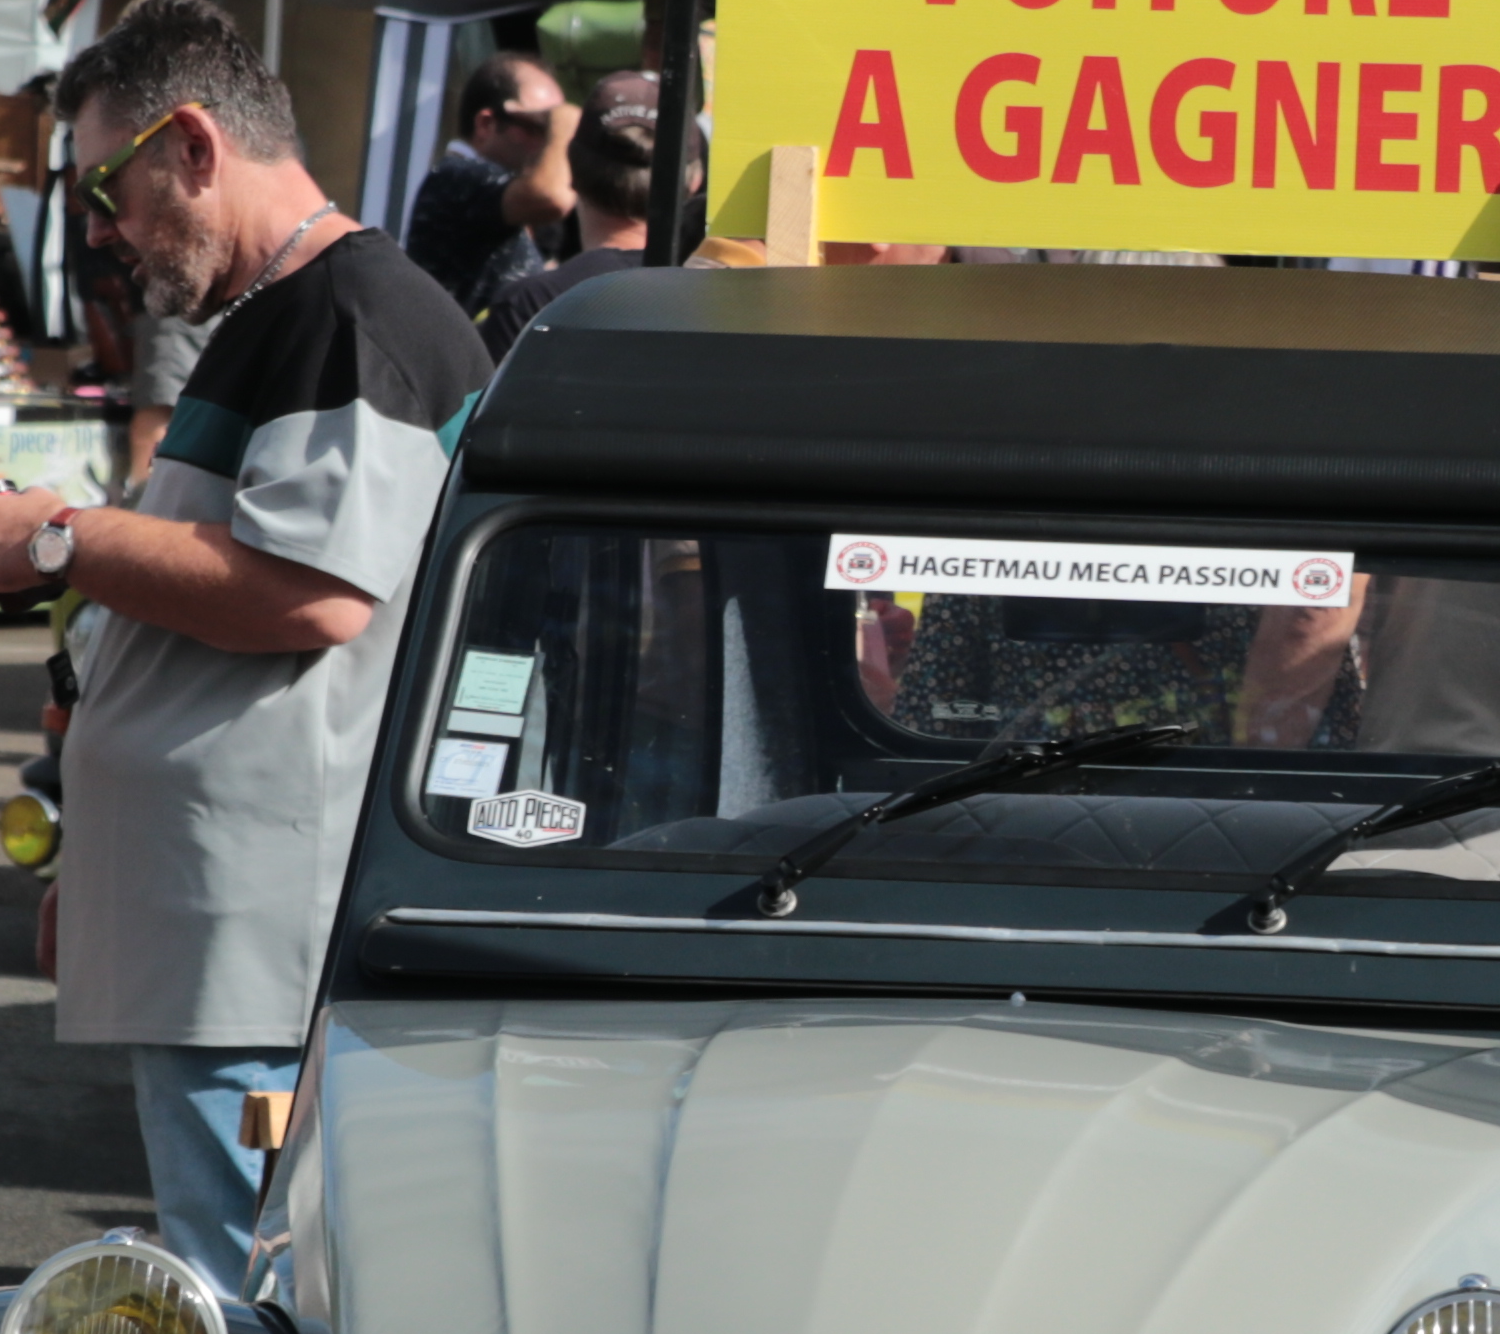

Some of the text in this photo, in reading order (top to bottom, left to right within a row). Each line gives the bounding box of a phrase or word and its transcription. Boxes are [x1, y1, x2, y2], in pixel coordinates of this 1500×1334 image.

[822, 49, 914, 180] A
[899, 554, 1061, 582] HAGETMAU
[1069, 560, 1150, 585] MECA
[1158, 563, 1281, 589] PASSION
[474, 798, 579, 830] AUTO PIECES
[514, 829, 533, 840] 40
